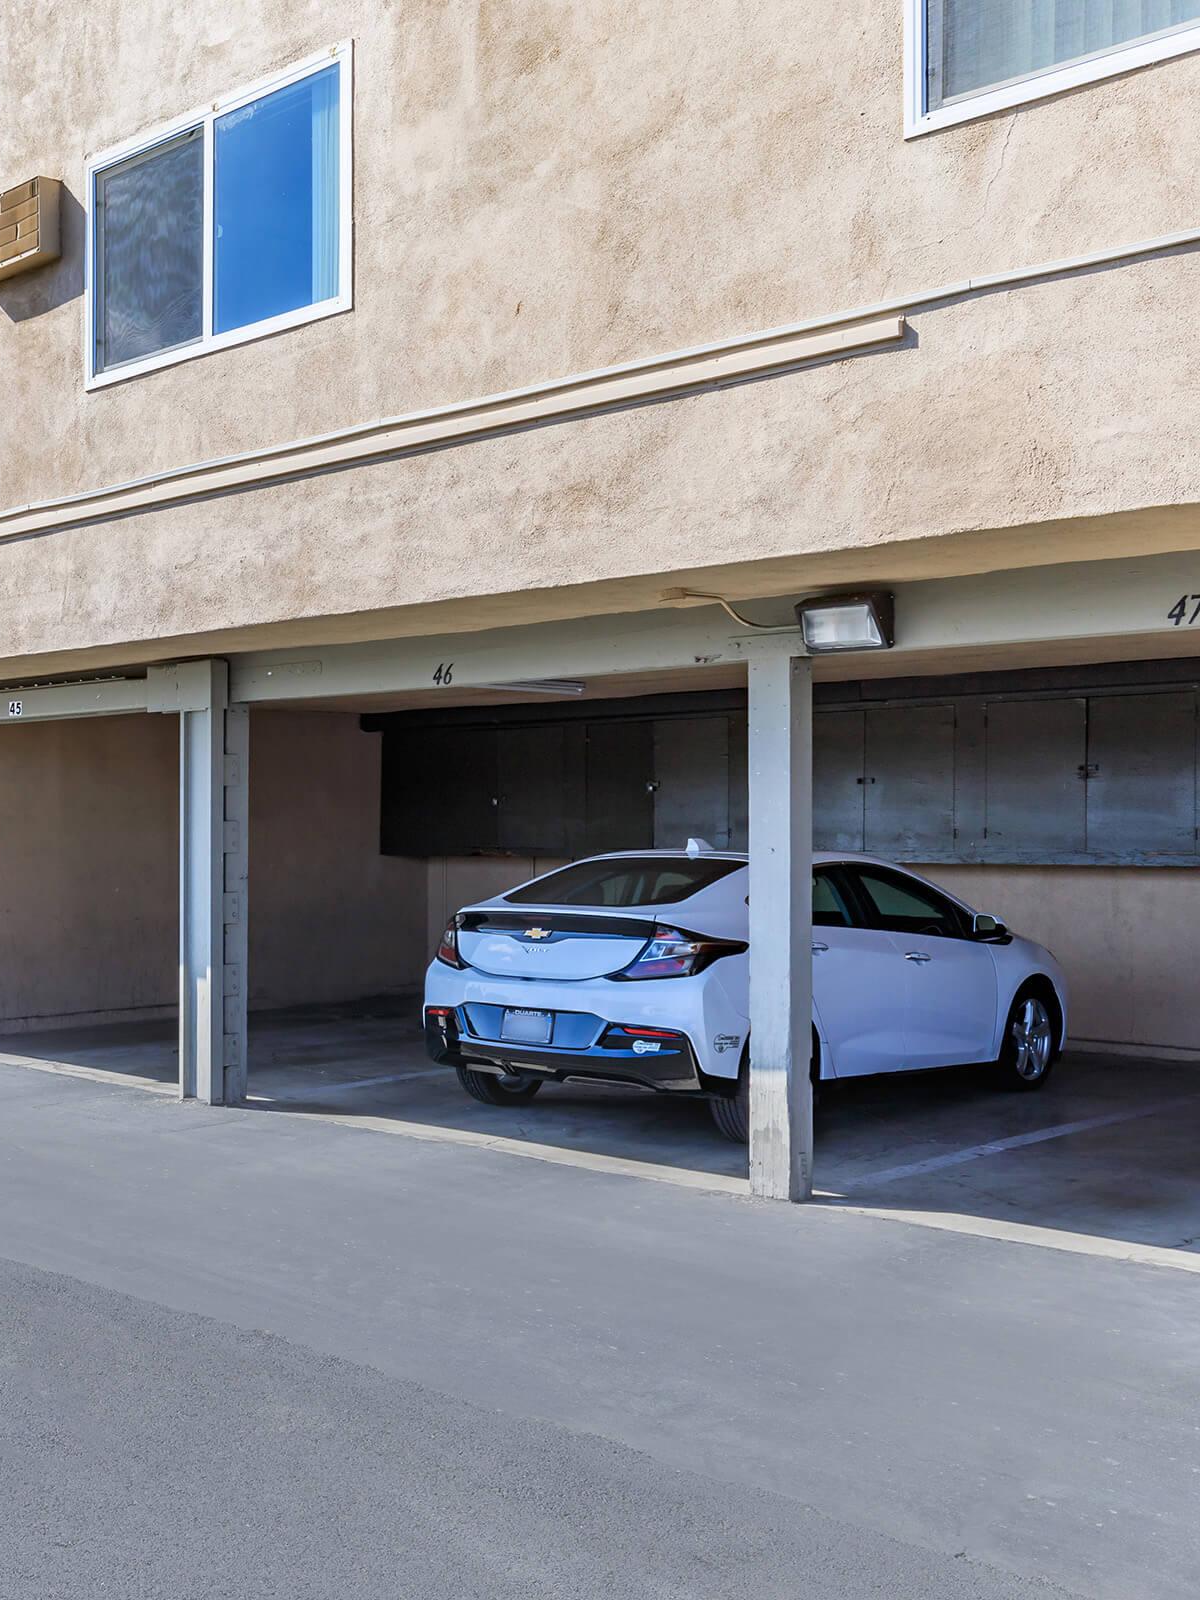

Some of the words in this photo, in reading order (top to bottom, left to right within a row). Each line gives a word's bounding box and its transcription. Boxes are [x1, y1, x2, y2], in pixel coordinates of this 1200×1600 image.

[1167, 595, 1200, 625] 47
[432, 663, 454, 685] 46
[10, 702, 22, 715] 45
